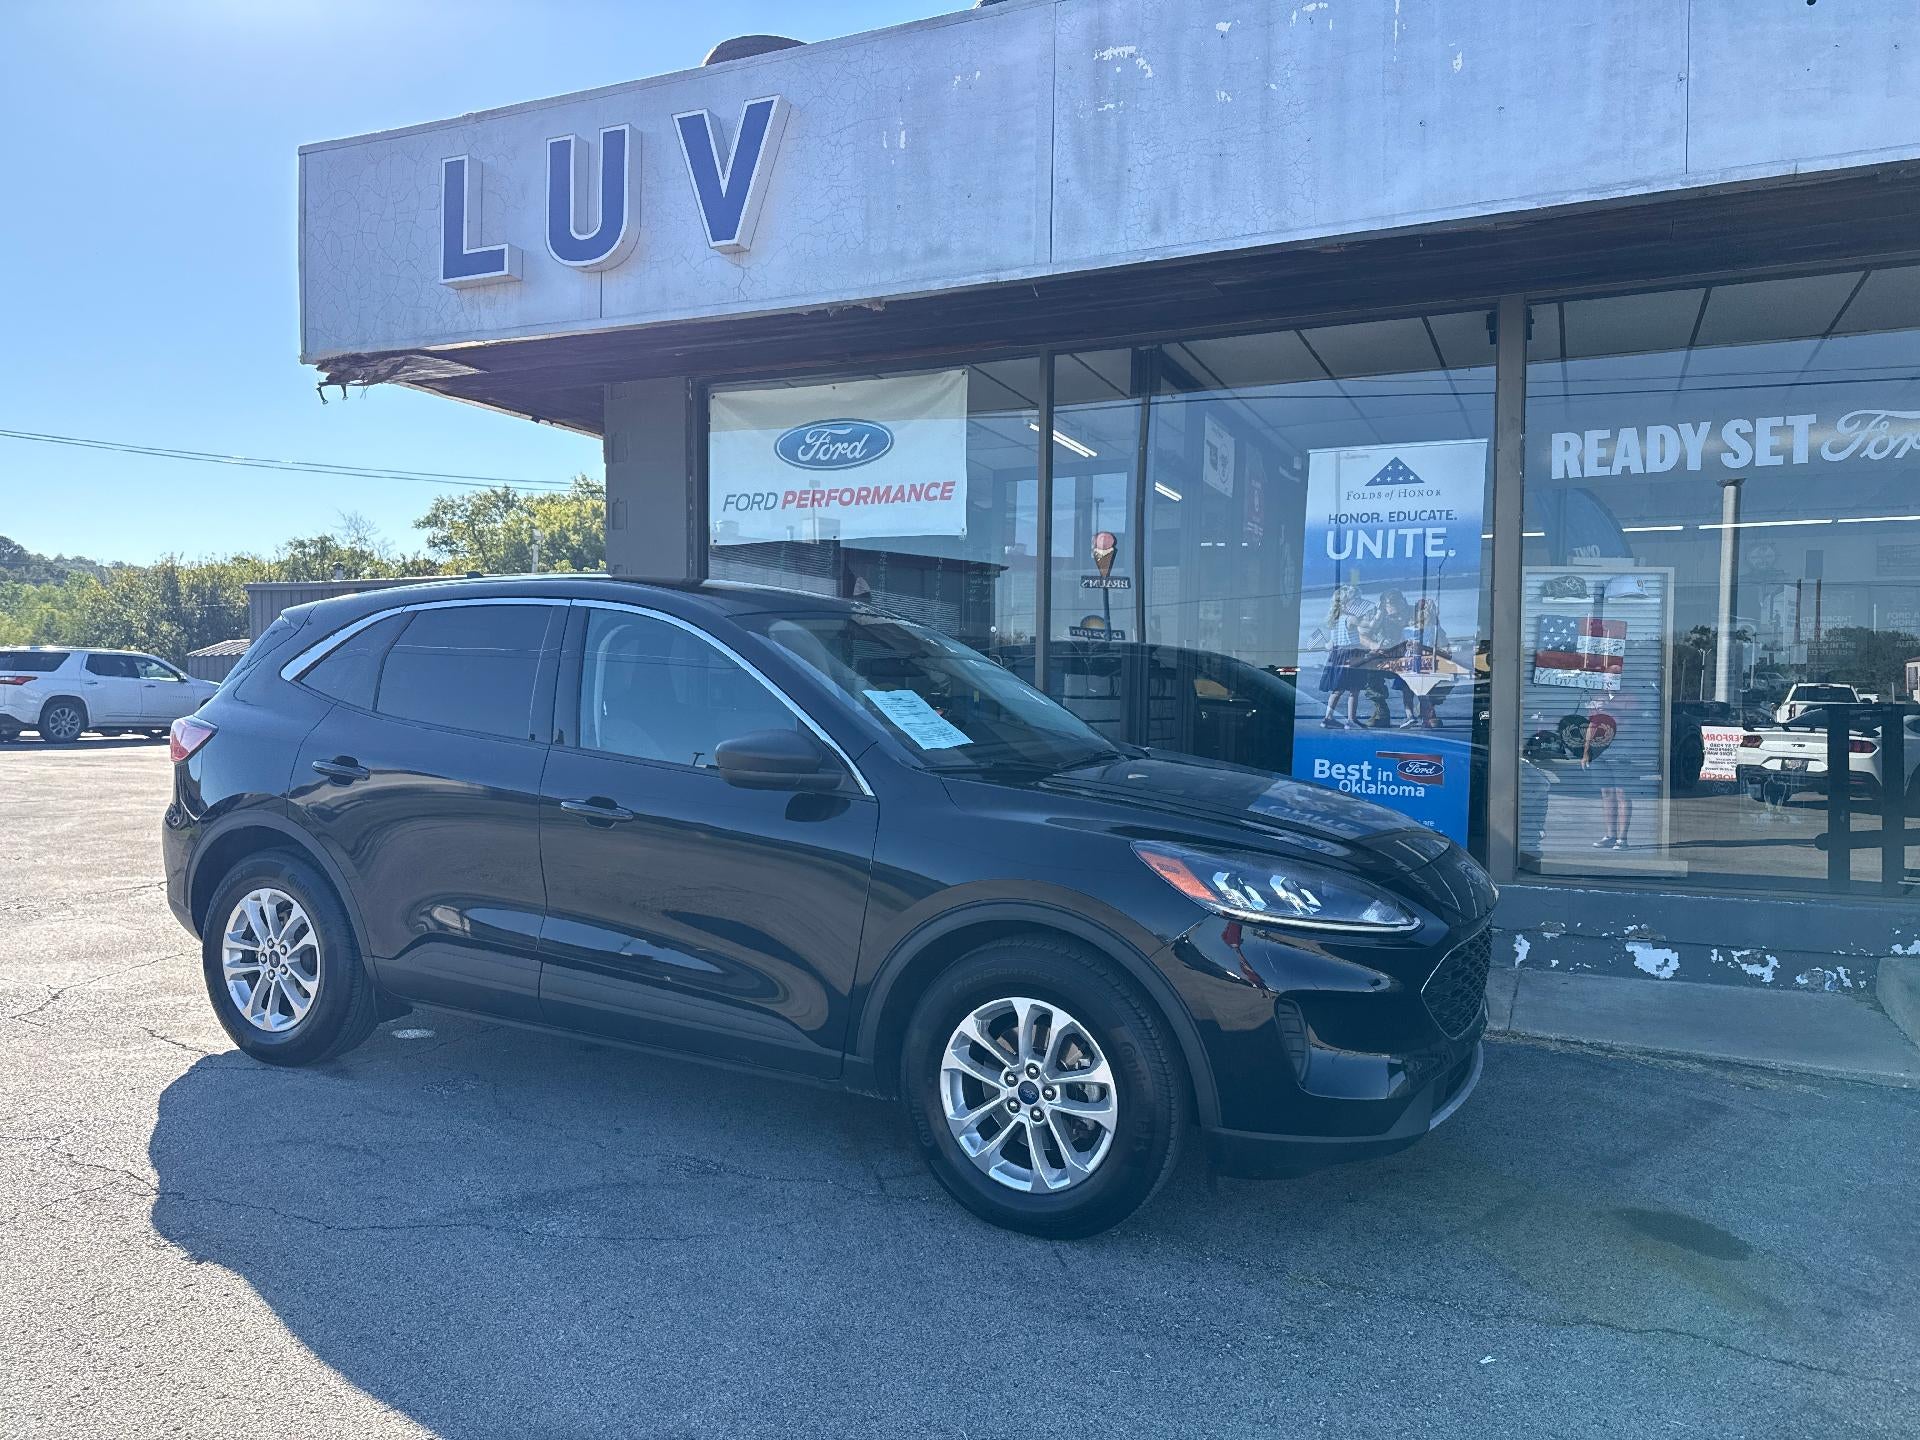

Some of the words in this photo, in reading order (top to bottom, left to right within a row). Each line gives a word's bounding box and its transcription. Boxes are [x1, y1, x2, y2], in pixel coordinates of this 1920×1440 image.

[797, 427, 867, 461] Ford
[1551, 421, 1711, 479] READY
[1720, 413, 1816, 469] SET
[1821, 409, 1920, 461] For
[723, 492, 779, 512] FORD
[781, 480, 956, 510] PERFORMANCE
[1346, 489, 1383, 501] FOLDS
[1385, 489, 1395, 501] of
[1398, 487, 1441, 499] HONOR
[1328, 511, 1384, 525] HONOR.
[1388, 509, 1458, 523] EDUCATE.
[1326, 527, 1457, 560] UNITE.
[1313, 758, 1373, 781] Best
[1378, 768, 1393, 782] in
[1405, 761, 1436, 775] Ford
[1338, 779, 1426, 797] Oklahoma
